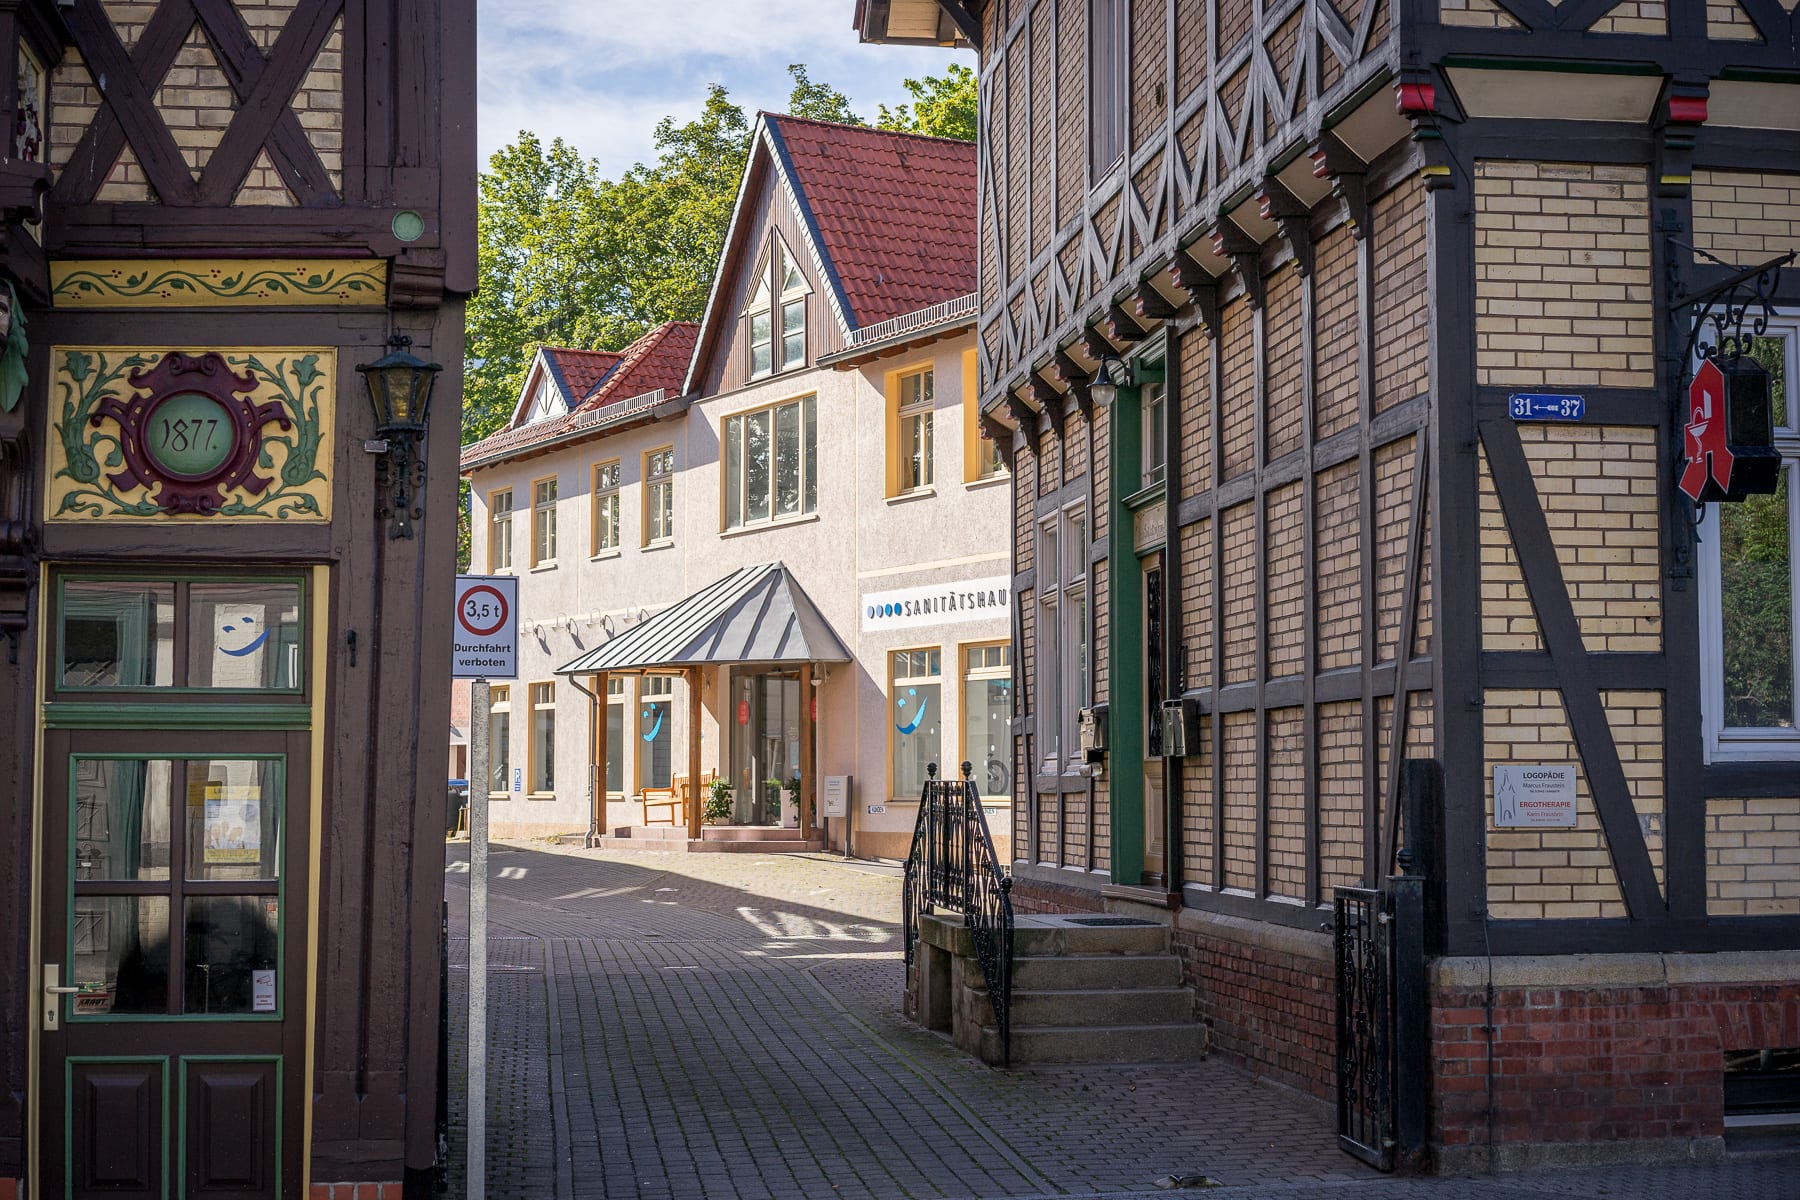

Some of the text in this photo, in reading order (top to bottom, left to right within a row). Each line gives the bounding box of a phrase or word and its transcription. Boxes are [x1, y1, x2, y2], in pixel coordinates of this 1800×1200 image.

[1514, 398, 1580, 417] 31 37
[466, 599, 500, 620] 3,5 t
[904, 588, 1012, 617] SANITÄTSHAU
[454, 643, 512, 653] Durchfahrt
[459, 657, 506, 667] verboten
[1523, 770, 1565, 779] LOGOPÄDIE
